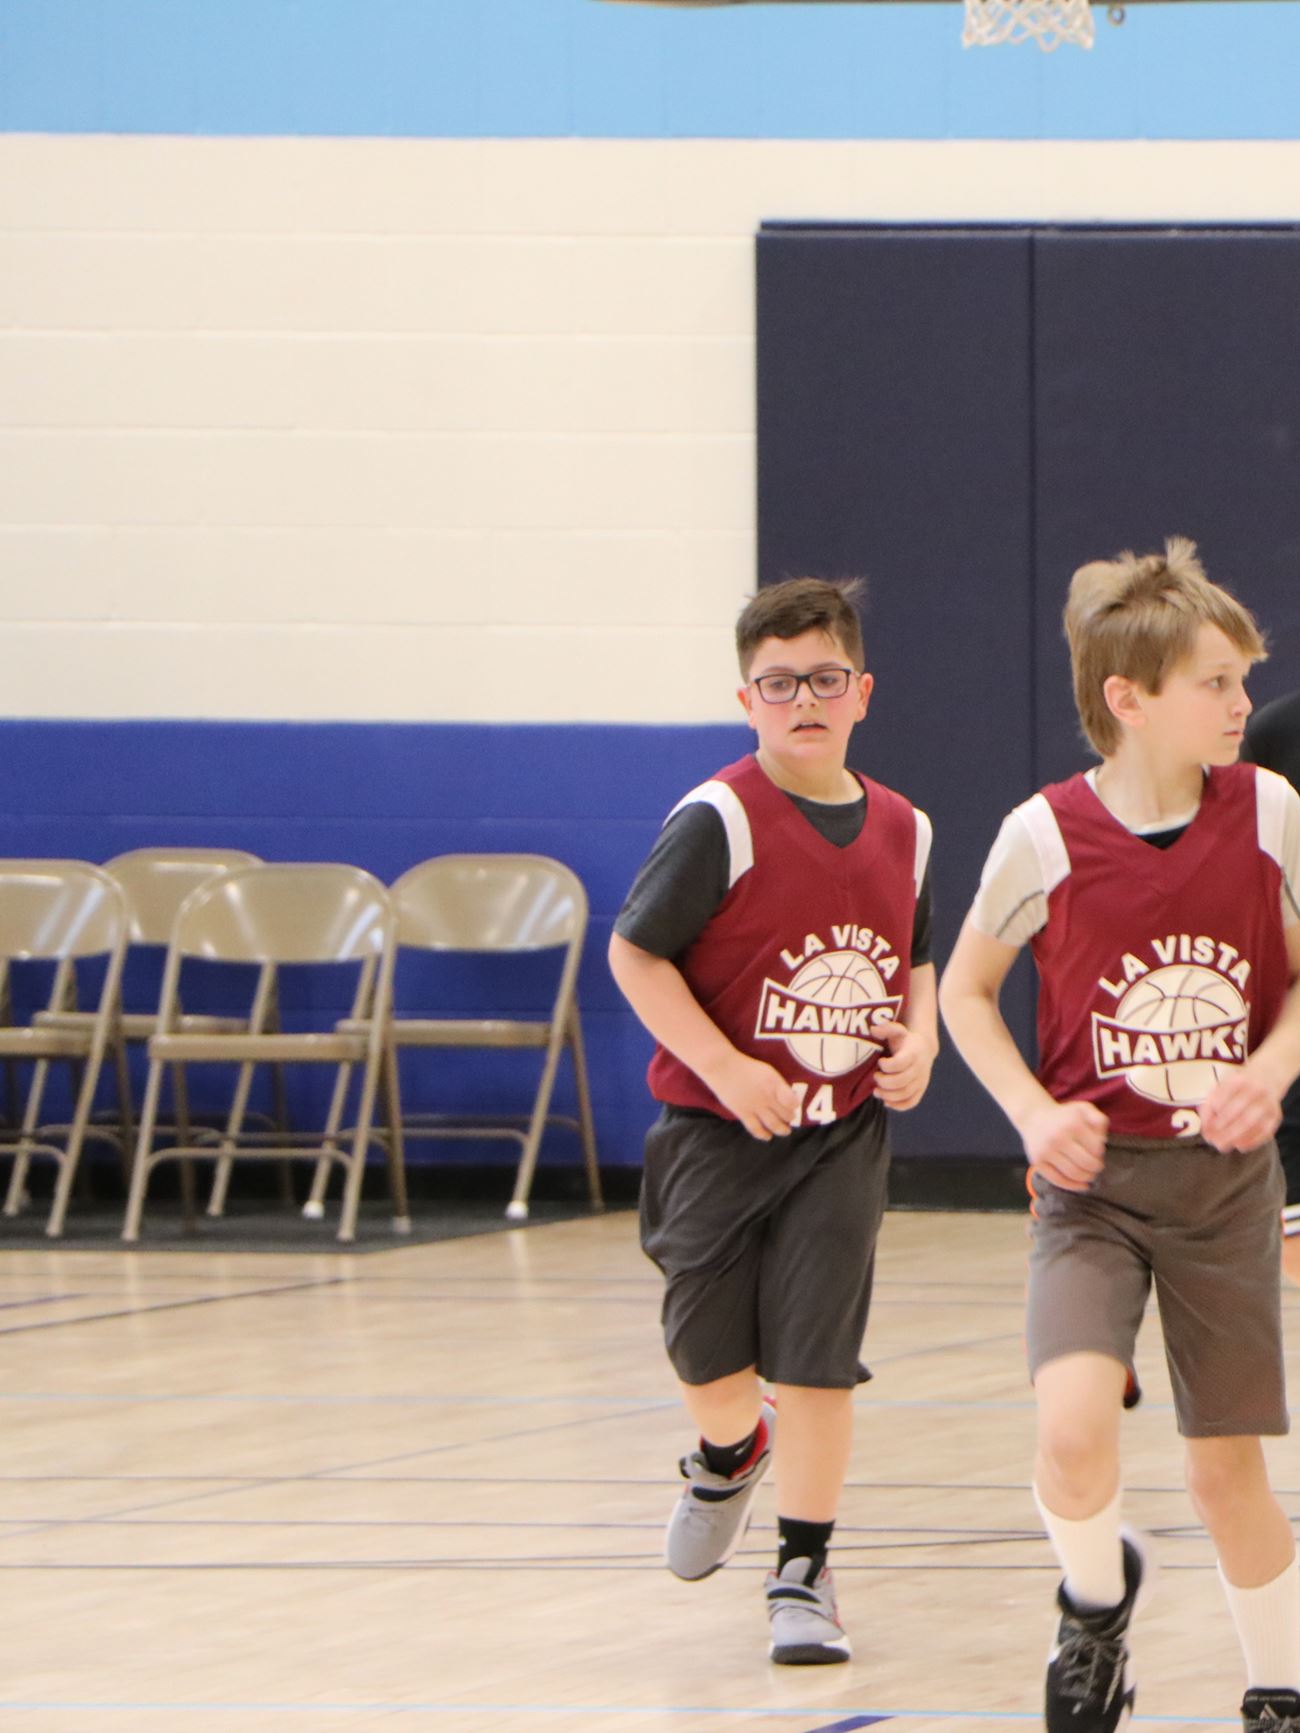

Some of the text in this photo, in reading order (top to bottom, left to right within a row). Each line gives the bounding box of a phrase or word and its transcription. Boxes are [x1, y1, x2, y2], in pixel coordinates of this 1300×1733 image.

[779, 924, 902, 981] LA VISTA
[1098, 933, 1252, 1000] LA VISTA
[764, 993, 895, 1037] HAWKS
